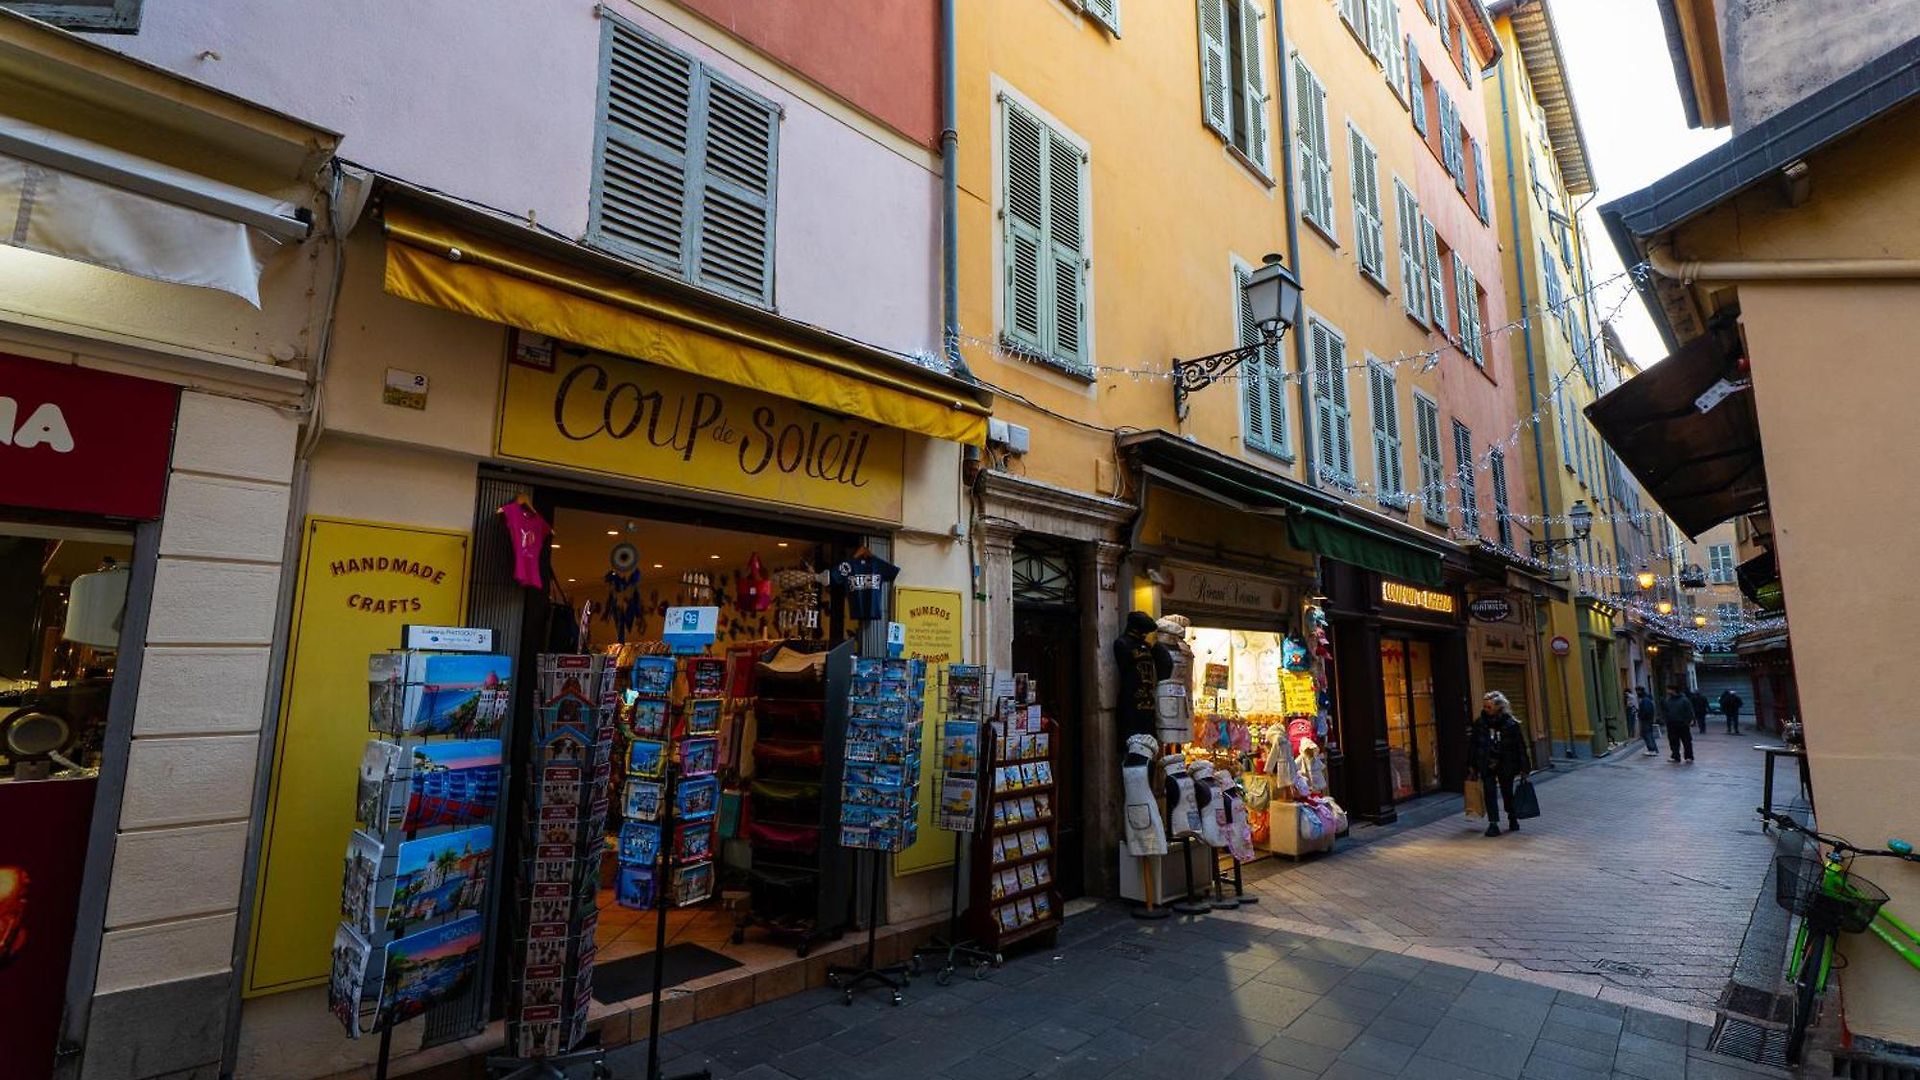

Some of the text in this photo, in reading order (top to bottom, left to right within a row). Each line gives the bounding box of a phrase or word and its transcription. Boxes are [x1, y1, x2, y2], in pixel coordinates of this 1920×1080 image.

[414, 375, 425, 386] 2
[712, 418, 737, 445] de
[738, 406, 869, 488] Soleil
[330, 557, 446, 585] HANDMADE
[848, 573, 881, 592] NICE
[347, 594, 422, 613] CRAFTS
